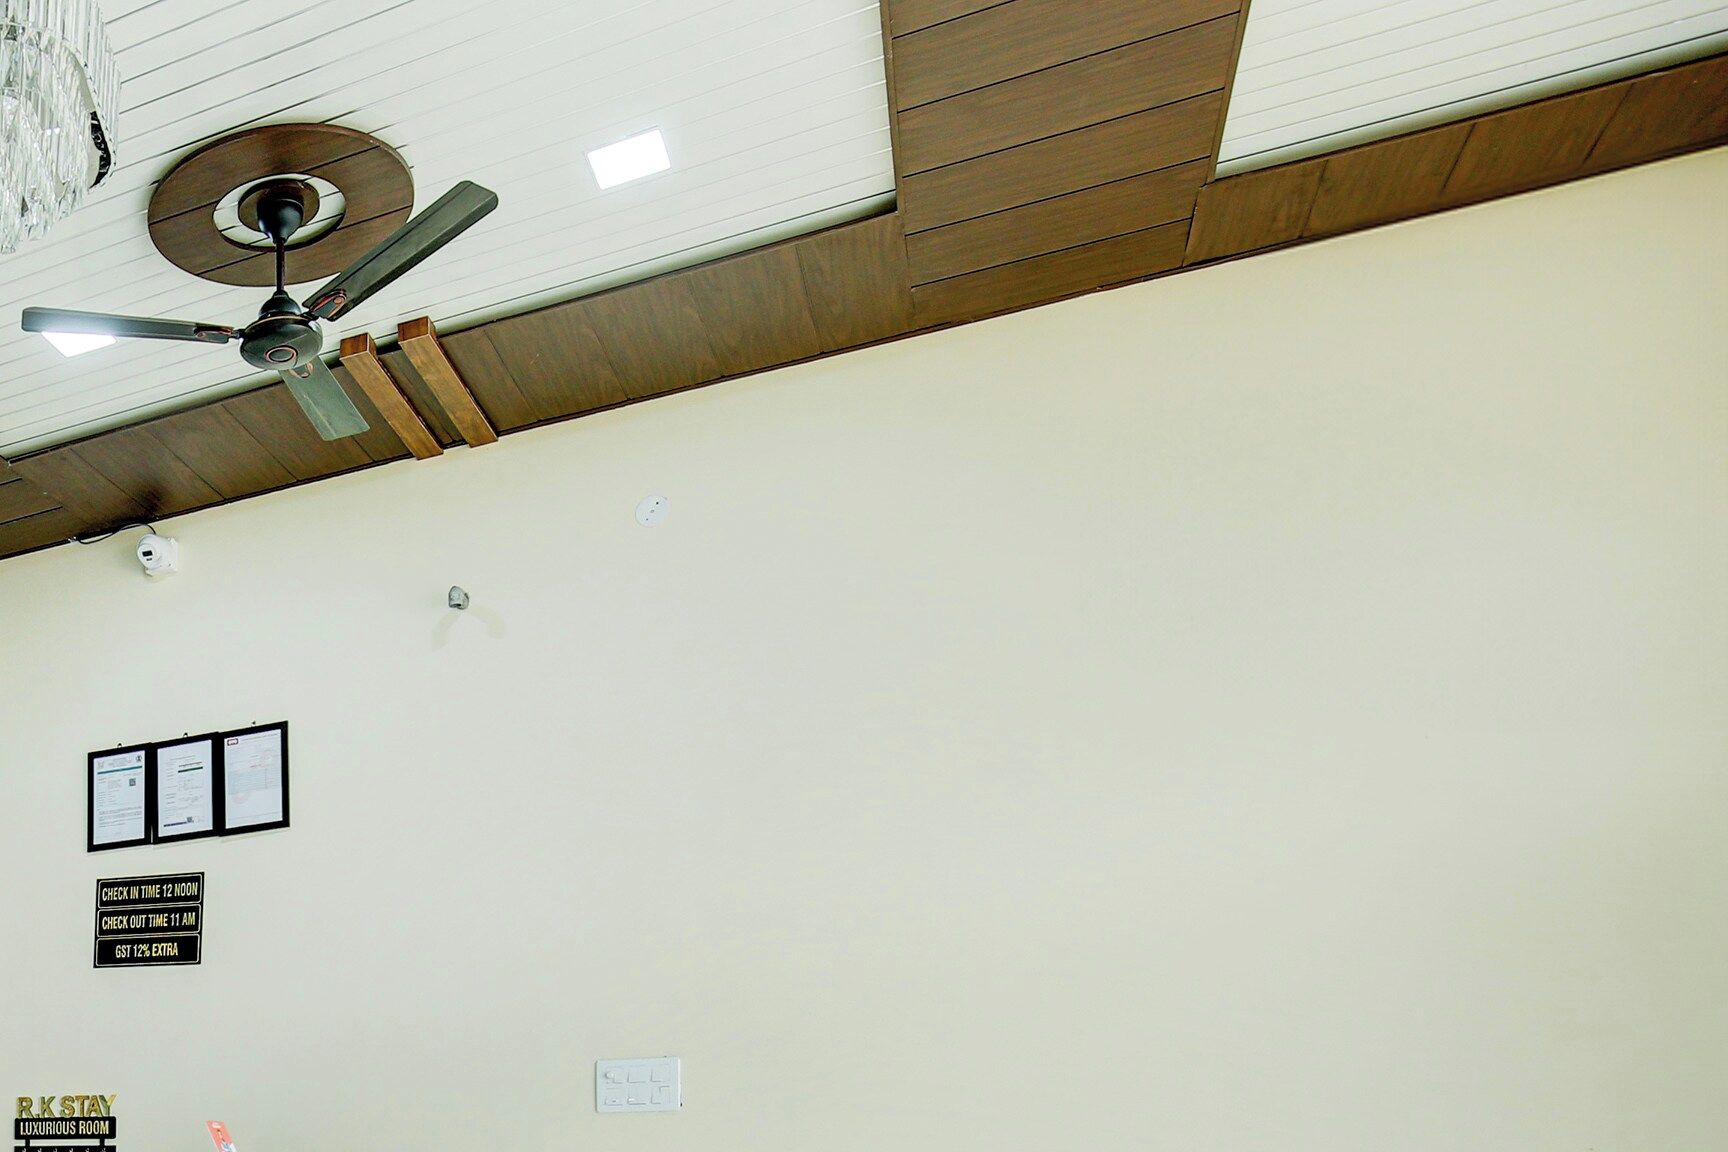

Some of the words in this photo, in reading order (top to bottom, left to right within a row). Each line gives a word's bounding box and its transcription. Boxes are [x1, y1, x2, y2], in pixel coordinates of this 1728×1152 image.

[102, 886, 129, 901] CHECK
[130, 886, 139, 899] IN
[141, 884, 161, 898] TIME
[162, 884, 172, 897] 12
[174, 882, 198, 897] NOON
[102, 915, 129, 930] CHECK
[130, 914, 147, 928] OUT
[148, 913, 168, 927] TIME
[170, 913, 180, 926] 11
[181, 912, 196, 926] AM
[115, 944, 132, 958] GST
[133, 943, 150, 957] 12%
[152, 942, 178, 957] EXTRA
[59, 1094, 117, 1118] STAY
[20, 1120, 76, 1135] LUXURIOUS
[79, 1120, 109, 1135] ROOM
